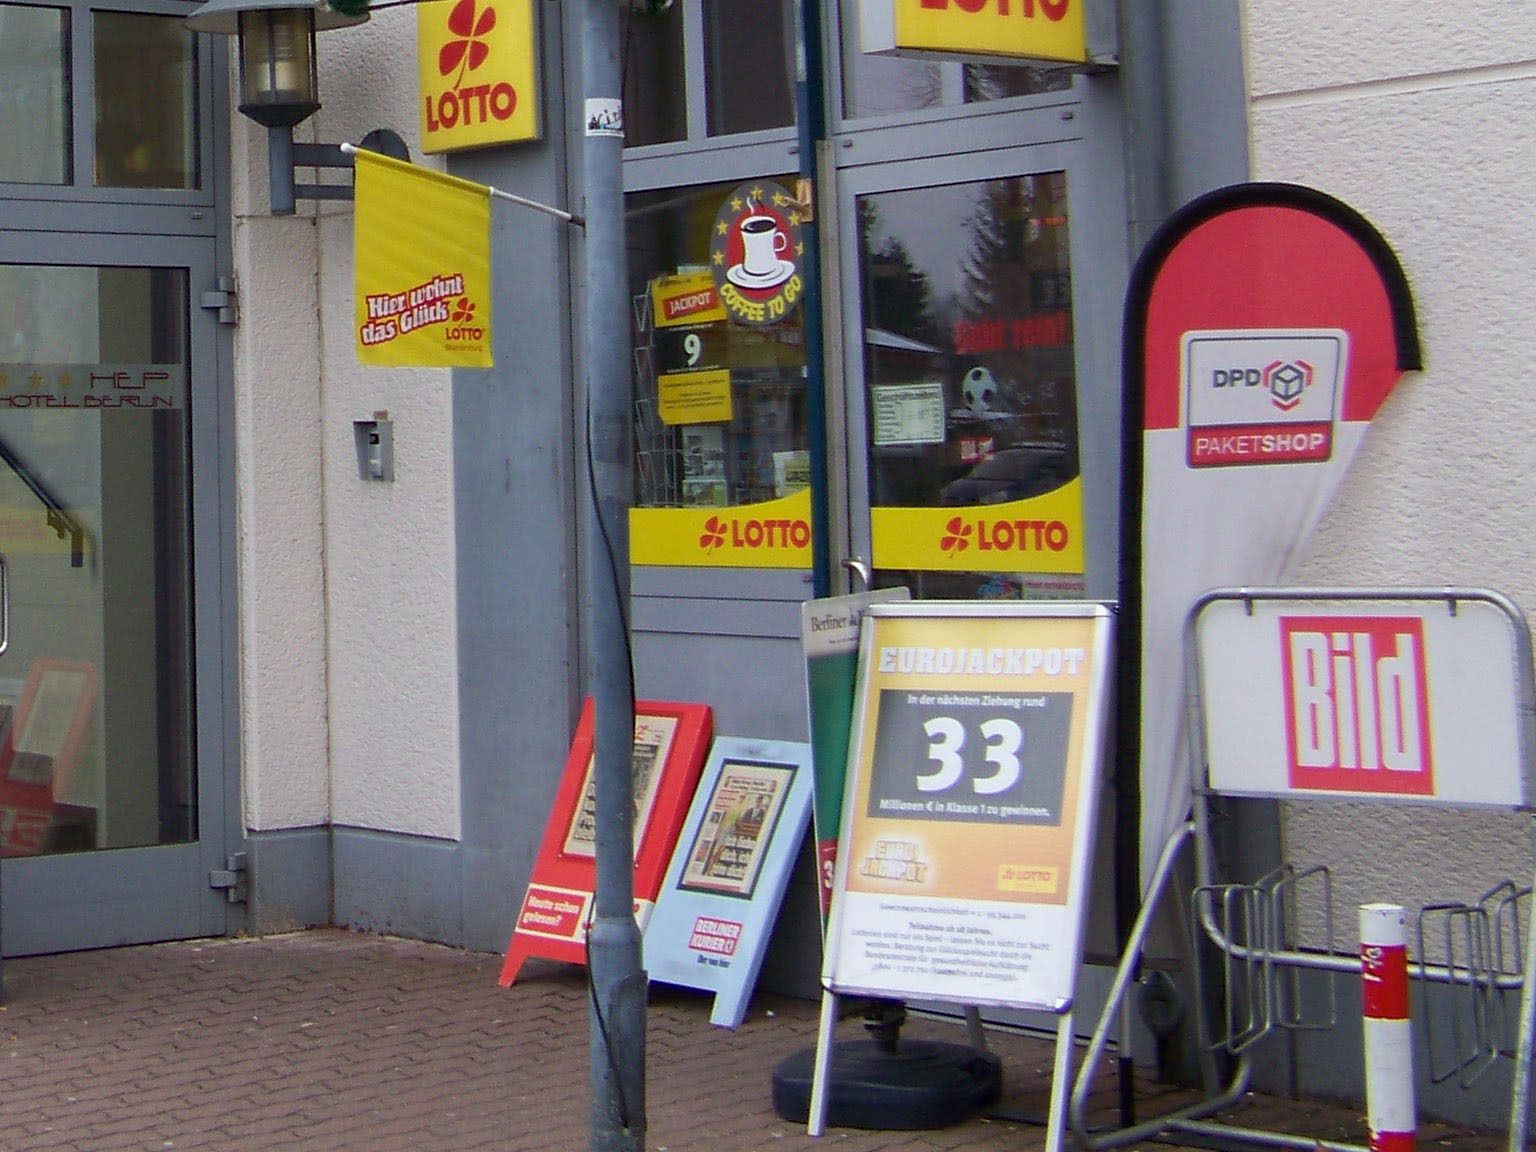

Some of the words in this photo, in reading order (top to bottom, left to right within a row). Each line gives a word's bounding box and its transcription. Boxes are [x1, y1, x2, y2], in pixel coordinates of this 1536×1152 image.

[426, 83, 517, 133] LOTTO
[367, 295, 407, 319] Hier
[410, 274, 464, 308] wohnt
[670, 291, 711, 316] JACKPOT
[720, 282, 764, 321] COFFEE
[768, 299, 785, 319] TO
[784, 274, 802, 302] GO
[362, 320, 396, 344] das
[400, 301, 450, 333] Glück
[445, 327, 482, 341] LOTTO
[684, 334, 702, 366] 9
[91, 371, 170, 390] HEP
[1214, 368, 1261, 389] DPD
[84, 395, 173, 408] BERLIN
[1196, 433, 1326, 456] PAKETSHOP
[732, 519, 811, 549] LOTTO
[978, 520, 1069, 552] LOTTO
[811, 613, 848, 632] Berliner
[877, 647, 1086, 677] EUROJACKPOT
[907, 694, 918, 705] In
[919, 694, 936, 706] der
[937, 695, 979, 708] nächsten
[981, 695, 1020, 710] Ziehung
[1022, 697, 1046, 708] rund
[1290, 631, 1422, 772] Bild
[879, 798, 924, 812] Millionen
[926, 800, 934, 812] €
[935, 800, 944, 812] in
[946, 801, 978, 815] Klasse
[986, 805, 998, 815] zu
[999, 805, 1050, 818] gewinnen.
[1016, 870, 1052, 882] LOTTO
[528, 895, 554, 910] Heute
[554, 901, 580, 915] schon
[522, 911, 562, 927] gelesen?
[695, 919, 740, 938] BERLINER
[691, 933, 725, 952] KURIER
